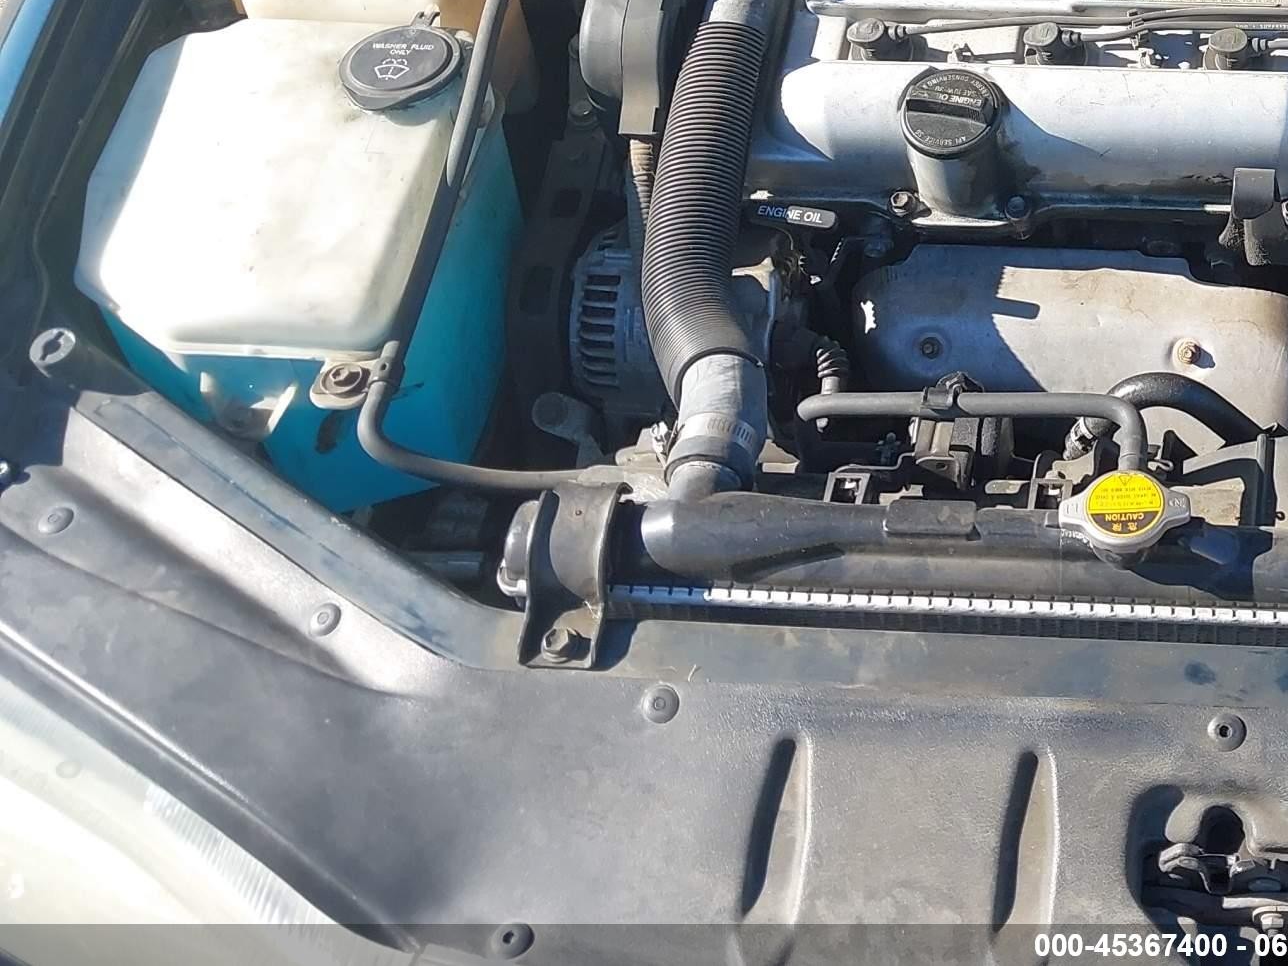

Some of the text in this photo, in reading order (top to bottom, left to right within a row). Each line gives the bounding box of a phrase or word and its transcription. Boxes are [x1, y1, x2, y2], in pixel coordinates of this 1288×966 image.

[372, 42, 435, 51] WASHER FLUID
[949, 94, 982, 106] ENGINE
[925, 136, 953, 146] SERVICE
[757, 205, 823, 224] ENGINE OIL
[1105, 512, 1145, 522] CAUTION
